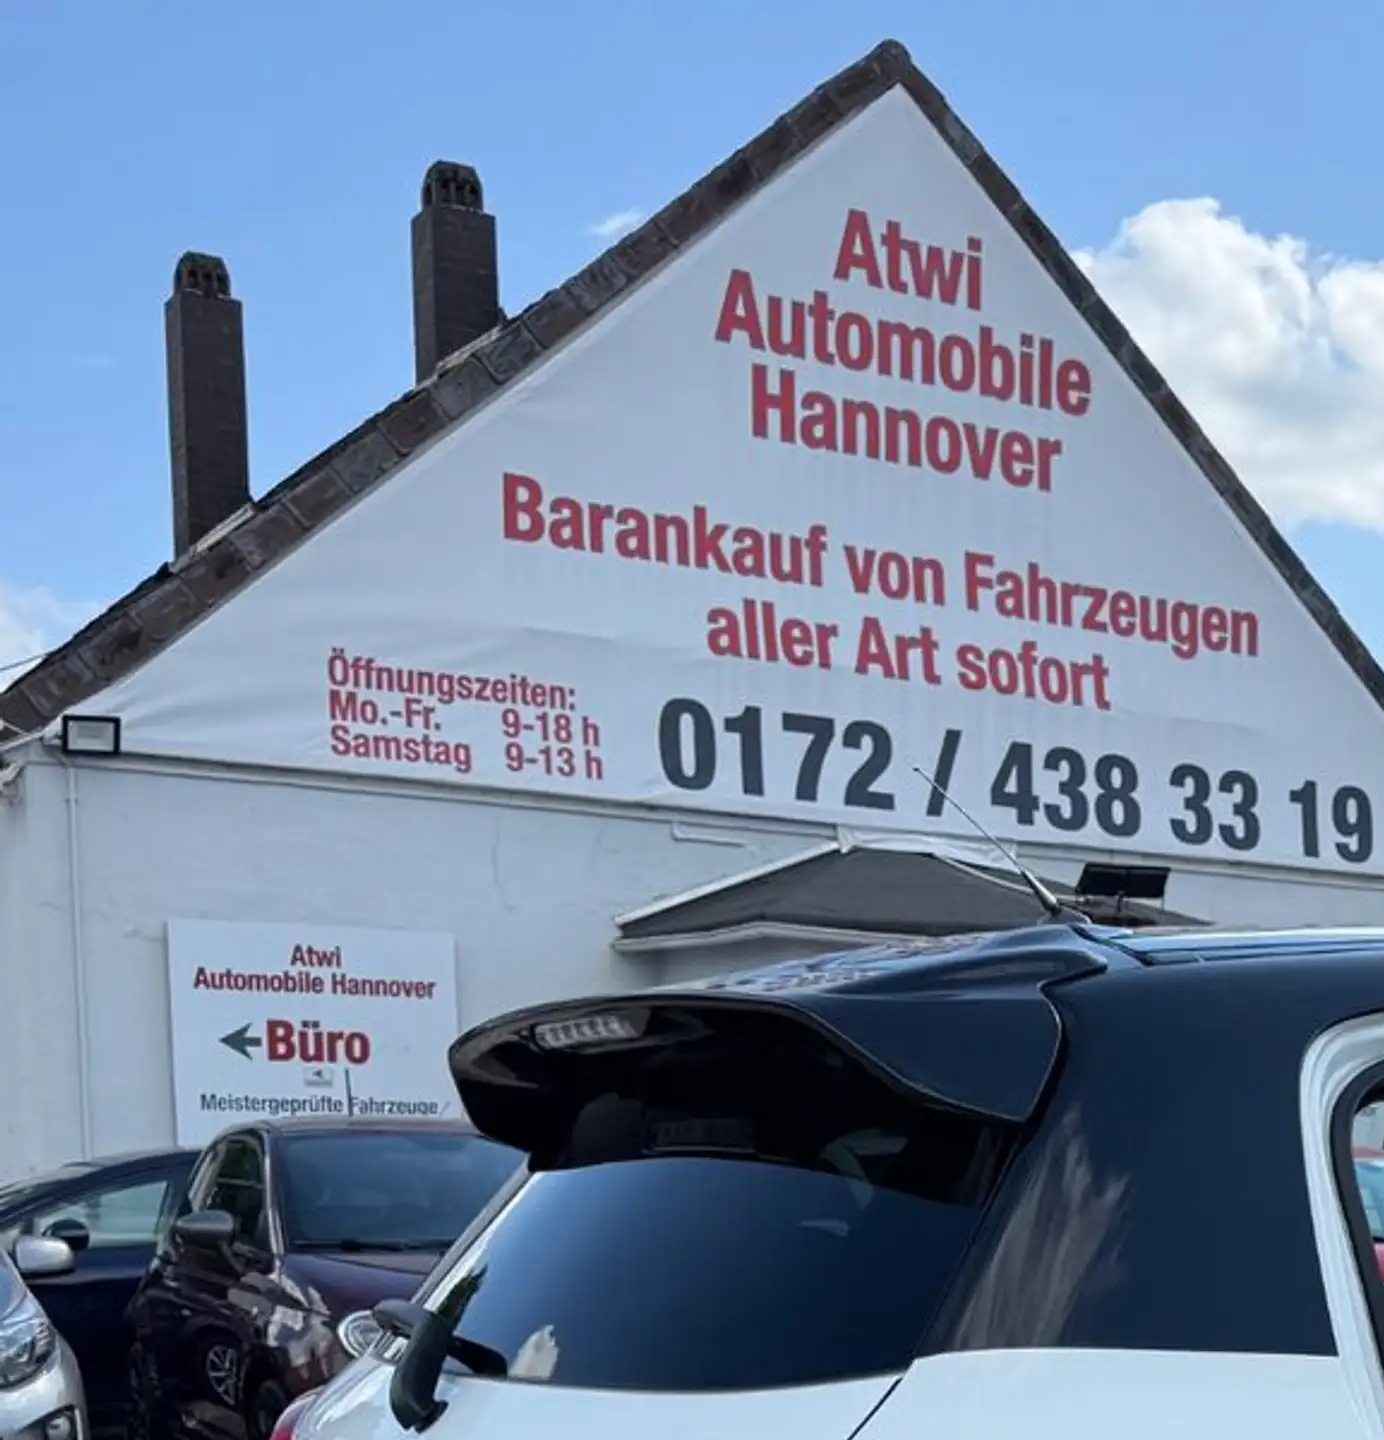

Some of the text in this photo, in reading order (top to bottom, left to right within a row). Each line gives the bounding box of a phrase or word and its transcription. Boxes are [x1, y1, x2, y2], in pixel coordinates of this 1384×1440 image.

[834, 208, 983, 310] Atwi
[716, 269, 1091, 416] Automobile
[750, 364, 1062, 491] Hannover
[503, 472, 1259, 659] Barankauf von Fahrzeugen
[327, 648, 575, 711] Öffnungszeiten:
[707, 598, 1111, 710] aller Art sofort
[329, 690, 600, 746] Mo.-Fr. 9-18 h
[330, 725, 603, 780] Samstag 9-13 h
[659, 698, 1374, 864] 0172 / 438 33 19
[193, 967, 436, 999] Automobile Hannover
[290, 944, 342, 967] Atwi
[266, 1019, 371, 1065] Büro
[200, 1094, 343, 1116] Meistergeprüfte
